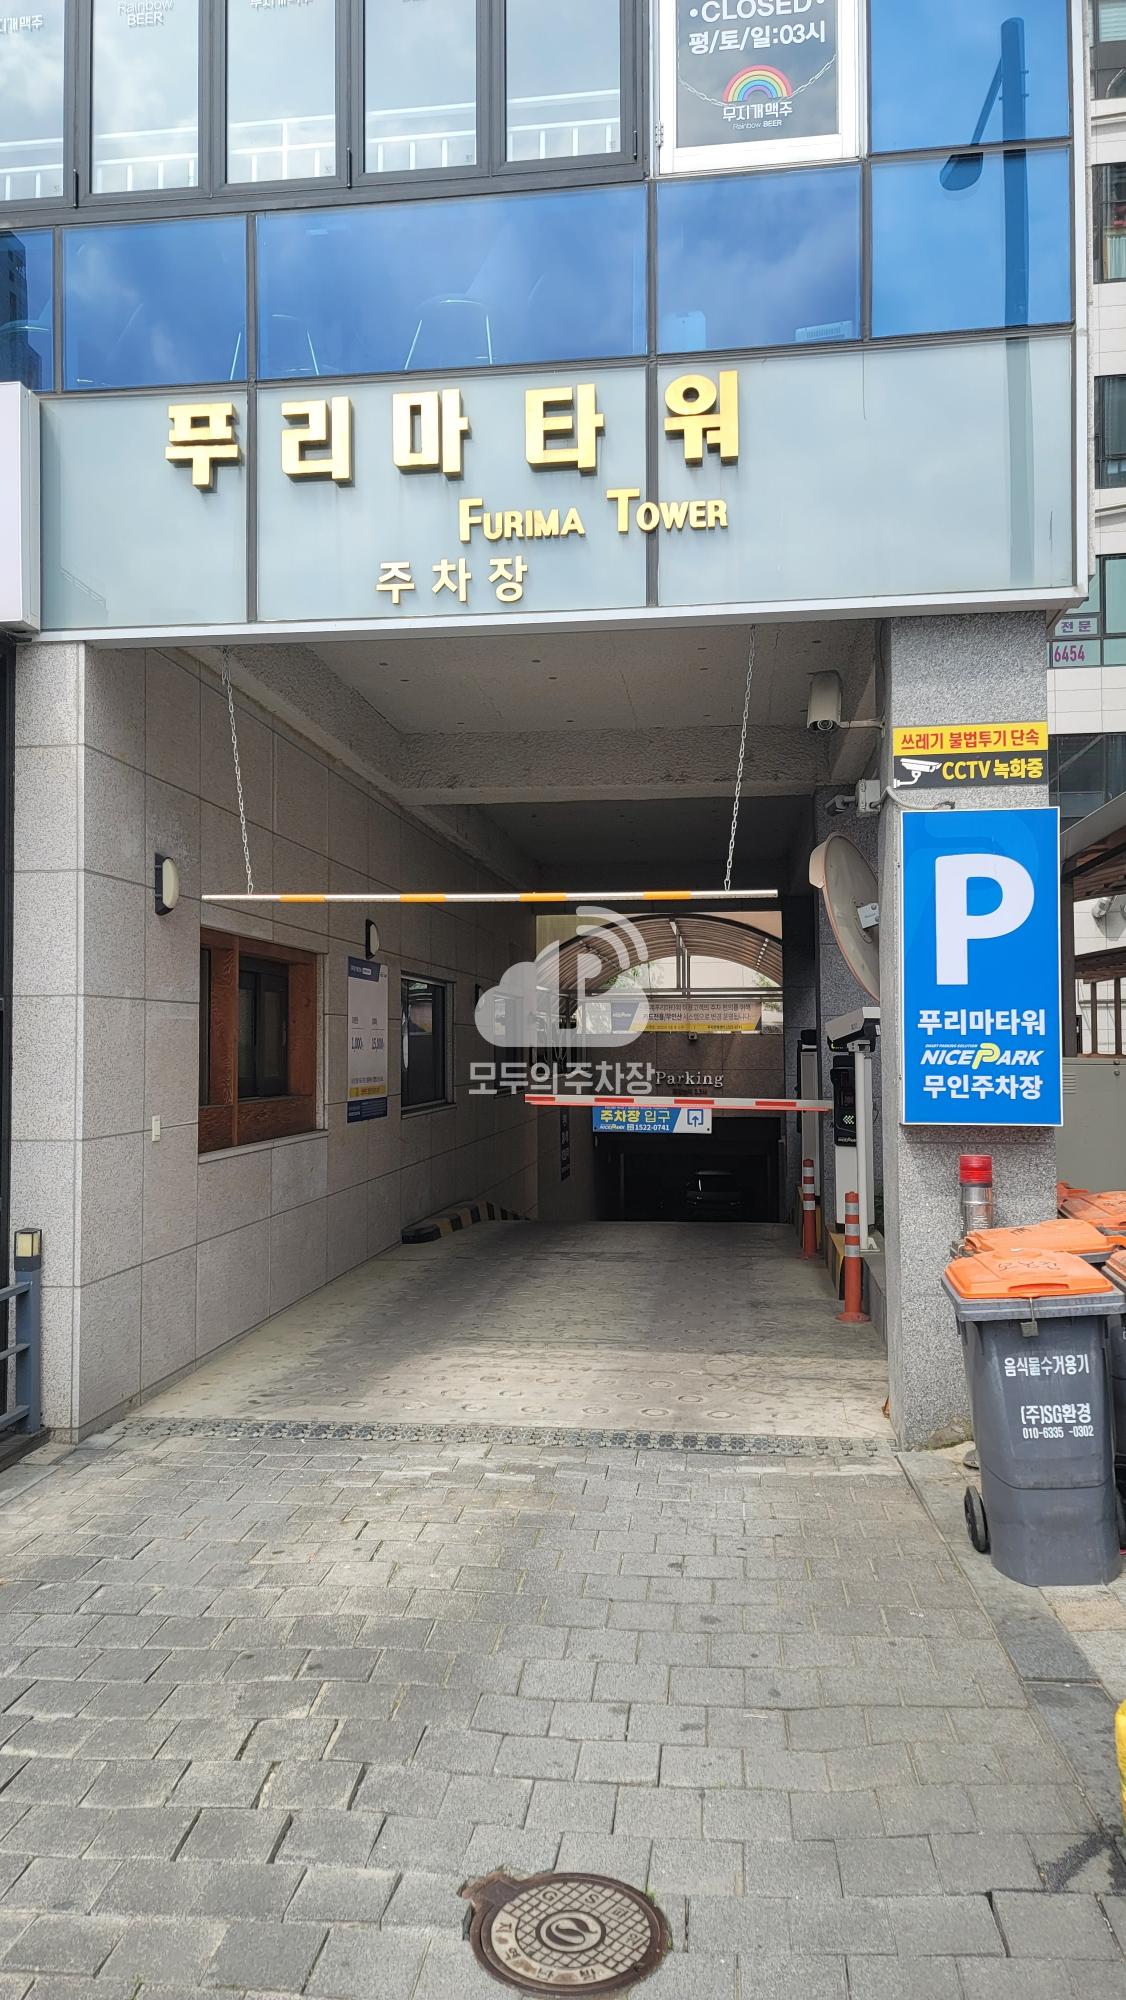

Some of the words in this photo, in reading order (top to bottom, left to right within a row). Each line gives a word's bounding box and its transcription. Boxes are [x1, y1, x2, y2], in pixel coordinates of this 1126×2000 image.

[127, 11, 163, 26] BEER
[722, 101, 793, 122] 무지개맥주
[732, 122, 762, 130] Rainbow
[763, 119, 783, 128] BEER
[165, 371, 739, 489] 푸리마타워
[375, 556, 528, 604] 주차장
[1054, 644, 1086, 662] 6454
[901, 733, 943, 750] 쓰레기
[949, 729, 1007, 749] 불법투기
[1011, 728, 1039, 746] 단속
[942, 760, 991, 780] CCTV
[993, 757, 1044, 779] 녹화중
[935, 853, 1035, 985] P
[918, 1009, 1046, 1036] 푸리마타워
[920, 1042, 1045, 1070] NICEPARK
[655, 1071, 724, 1088] Parking
[923, 1074, 1044, 1100] 무인주차장
[600, 1109, 640, 1123] 주차장
[644, 1110, 670, 1123] 입구
[1004, 1353, 1090, 1377] 음식물수거용기
[1022, 1426, 1064, 1439] 010-6335
